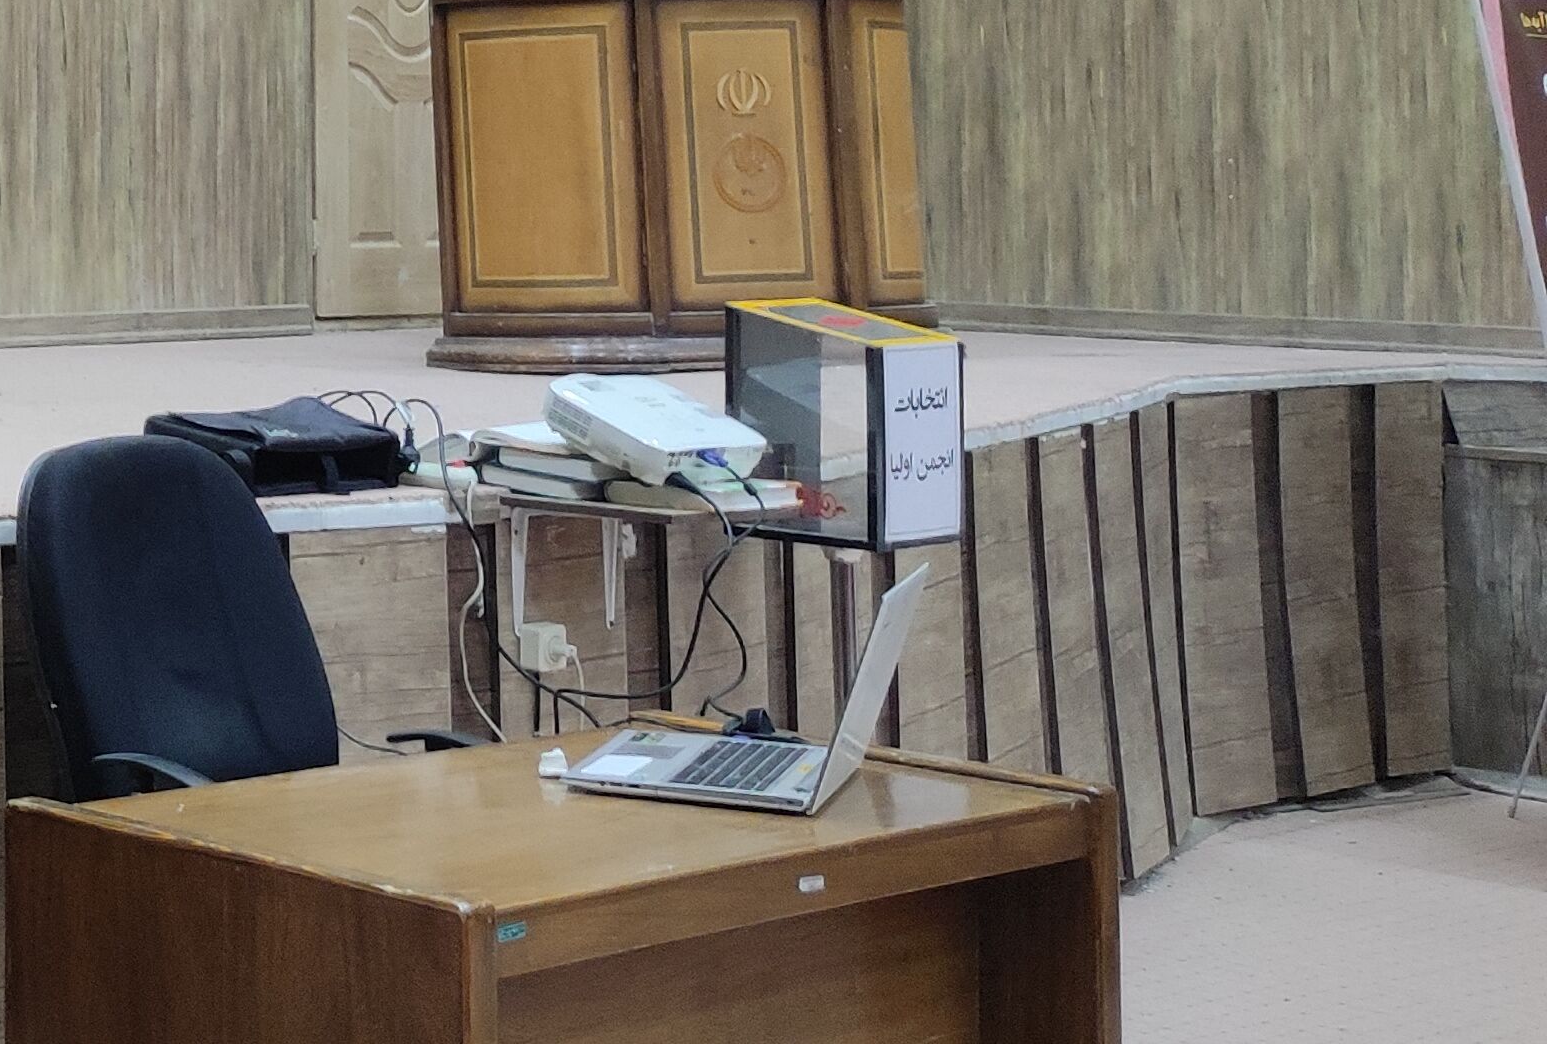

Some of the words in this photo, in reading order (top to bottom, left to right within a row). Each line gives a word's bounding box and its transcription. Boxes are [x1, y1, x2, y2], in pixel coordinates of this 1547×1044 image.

[894, 386, 949, 418] انتخابات
[890, 452, 913, 480] اولیا
[916, 448, 954, 481] انجمن
